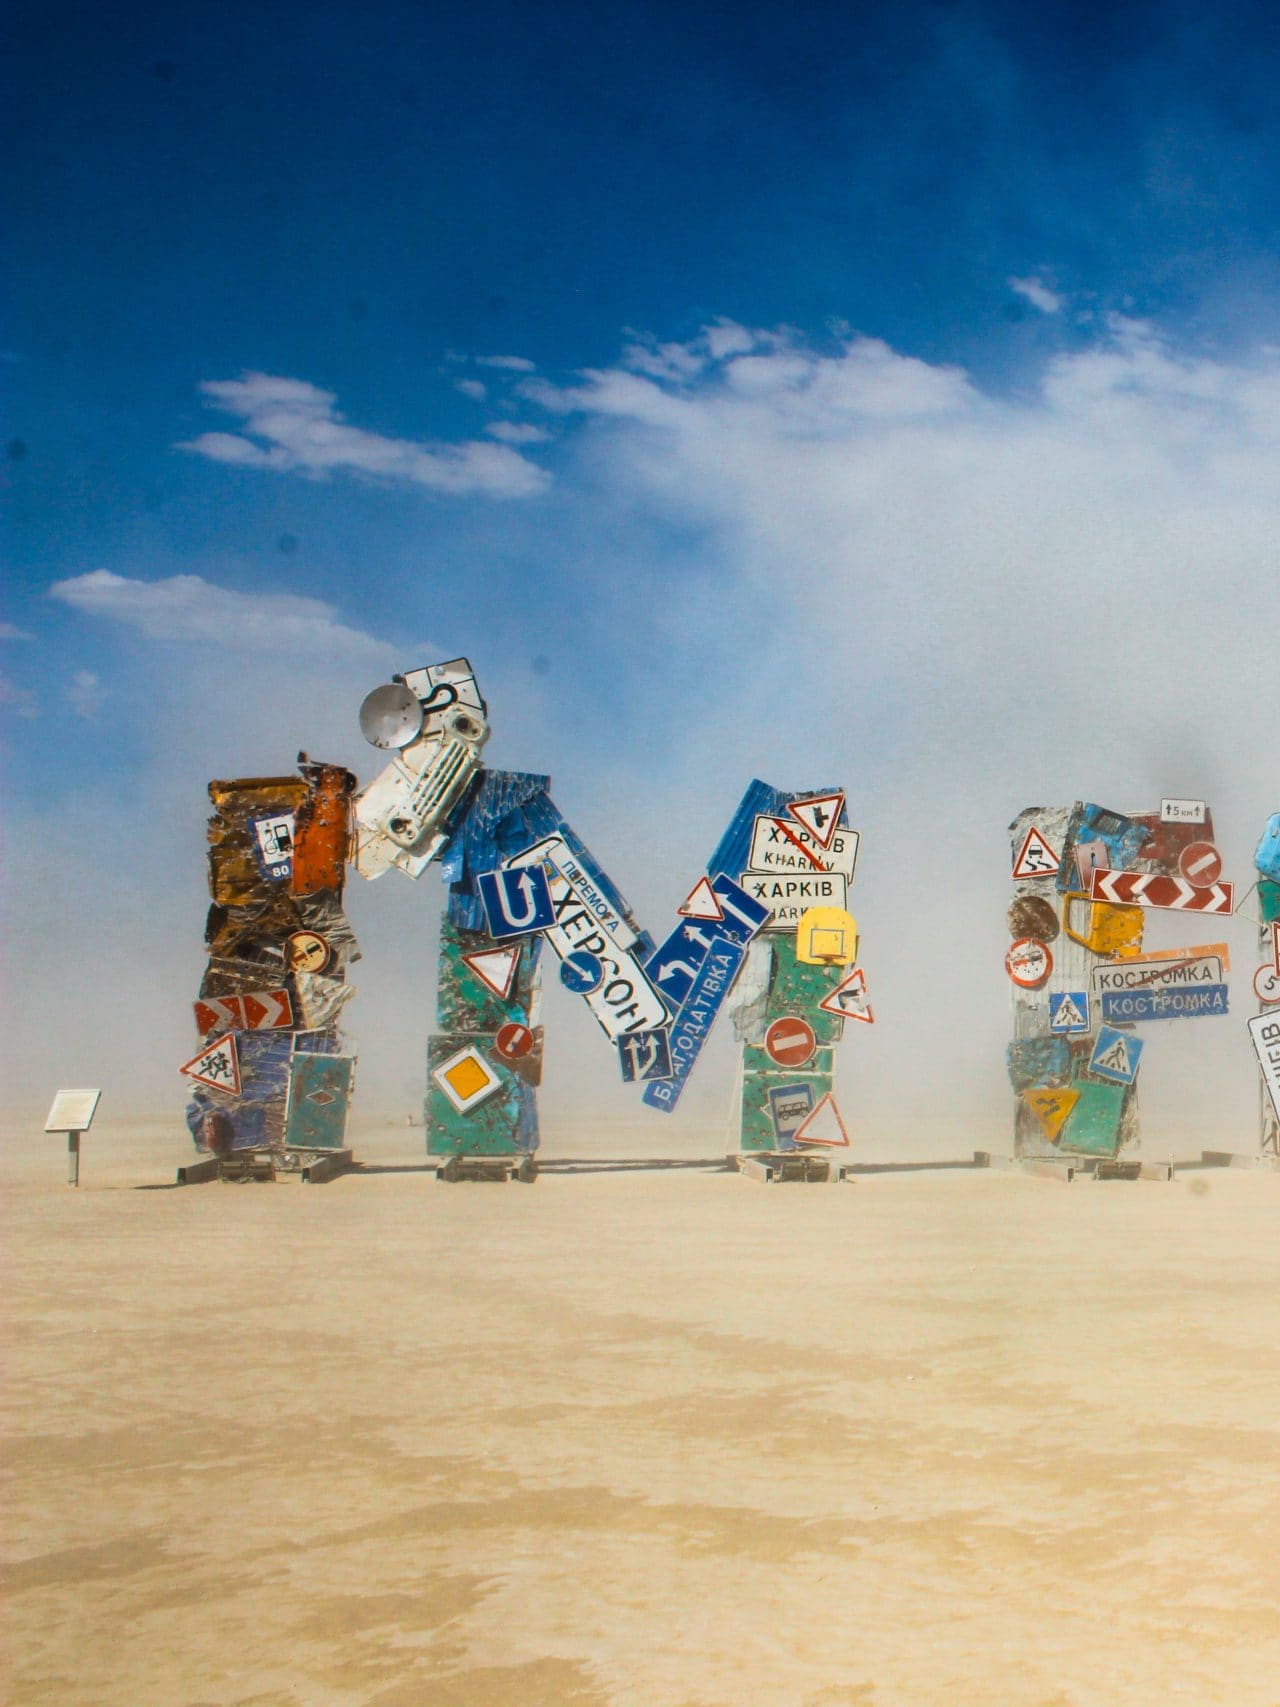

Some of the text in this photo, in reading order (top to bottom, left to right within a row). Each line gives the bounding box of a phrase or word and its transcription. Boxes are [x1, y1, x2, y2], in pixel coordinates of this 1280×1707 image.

[768, 826, 845, 853] ХАРВ
[272, 865, 290, 878] 80
[755, 881, 833, 899] ХАРКІВ
[1099, 966, 1213, 989] КОСТРОМКА
[1264, 975, 1279, 991] 5
[1108, 991, 1224, 1015] КОСТРОМКА
[654, 953, 733, 1102] БАГОДАТІВКА
